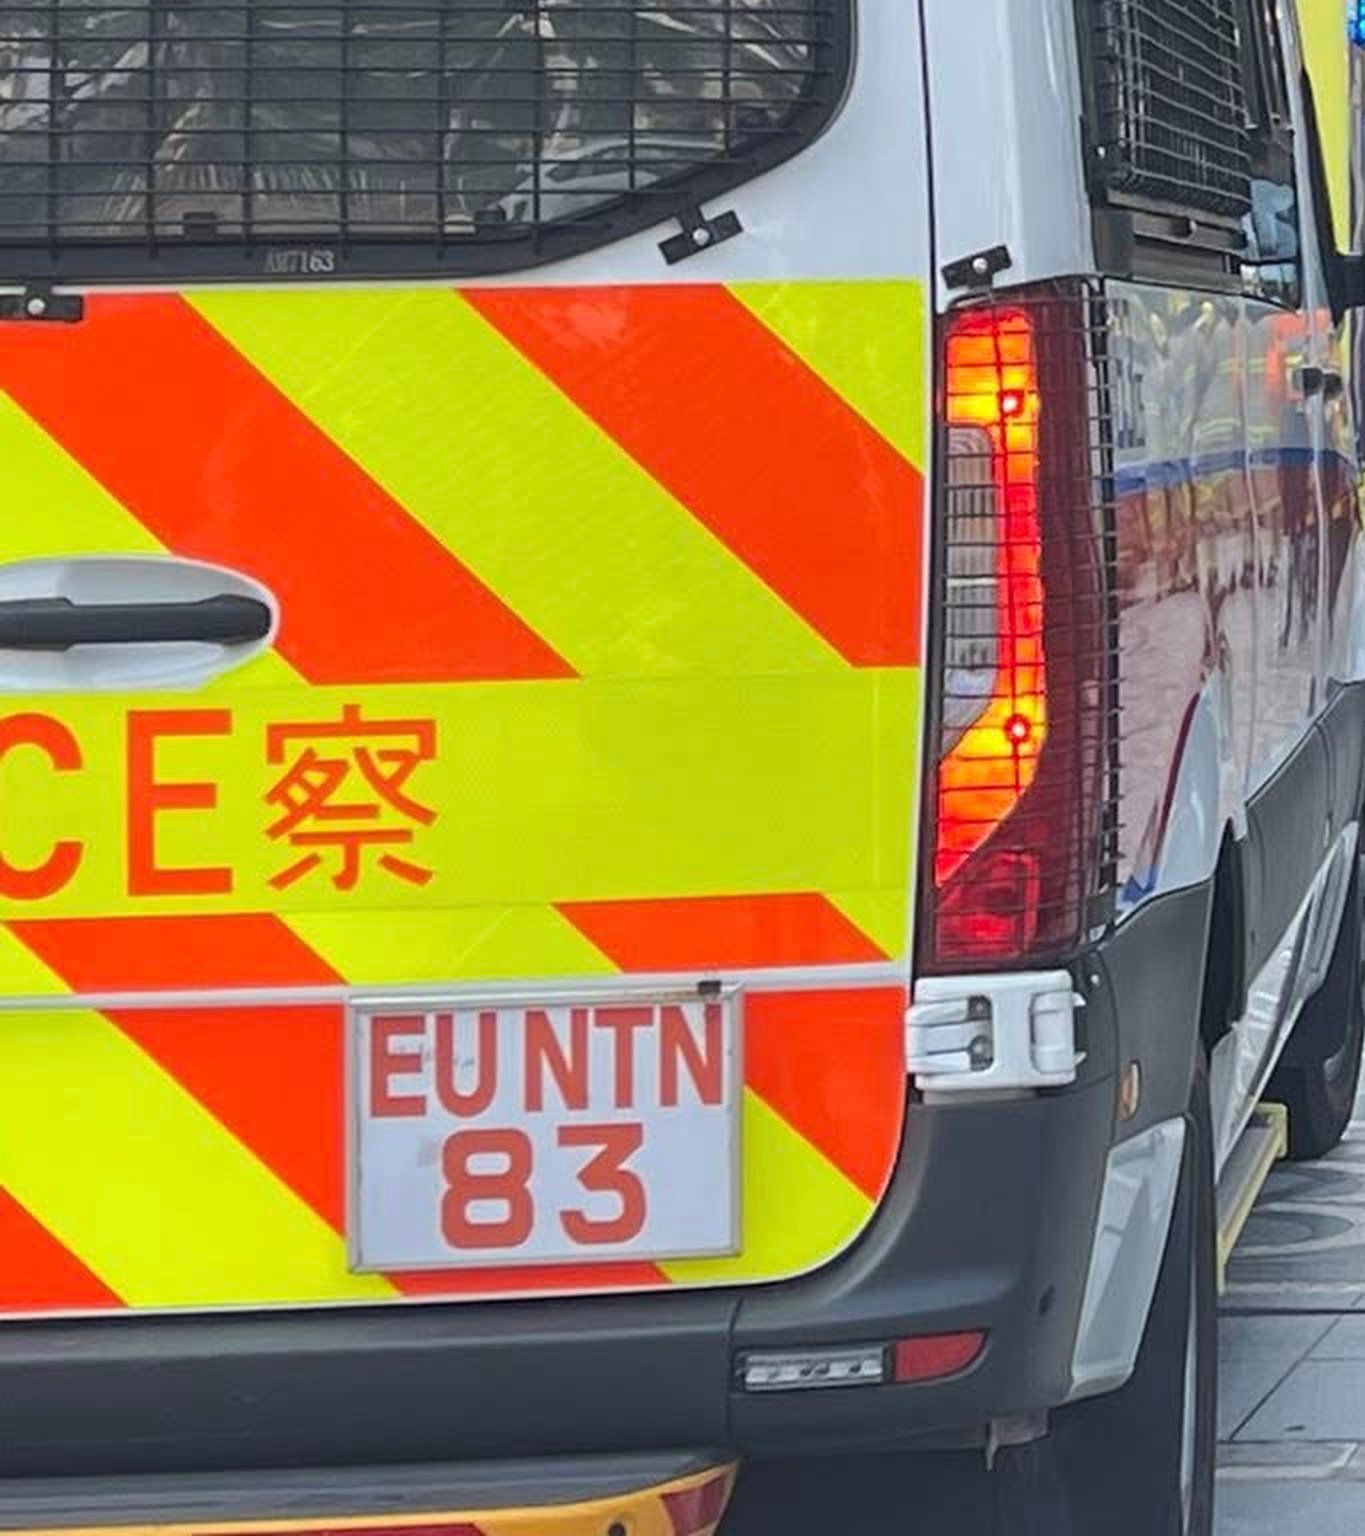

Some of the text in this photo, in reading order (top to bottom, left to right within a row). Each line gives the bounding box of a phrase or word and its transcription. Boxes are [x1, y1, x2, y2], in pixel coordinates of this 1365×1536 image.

[0, 709, 233, 901] CE
[264, 704, 438, 892] 察
[440, 1122, 648, 1249] 83
